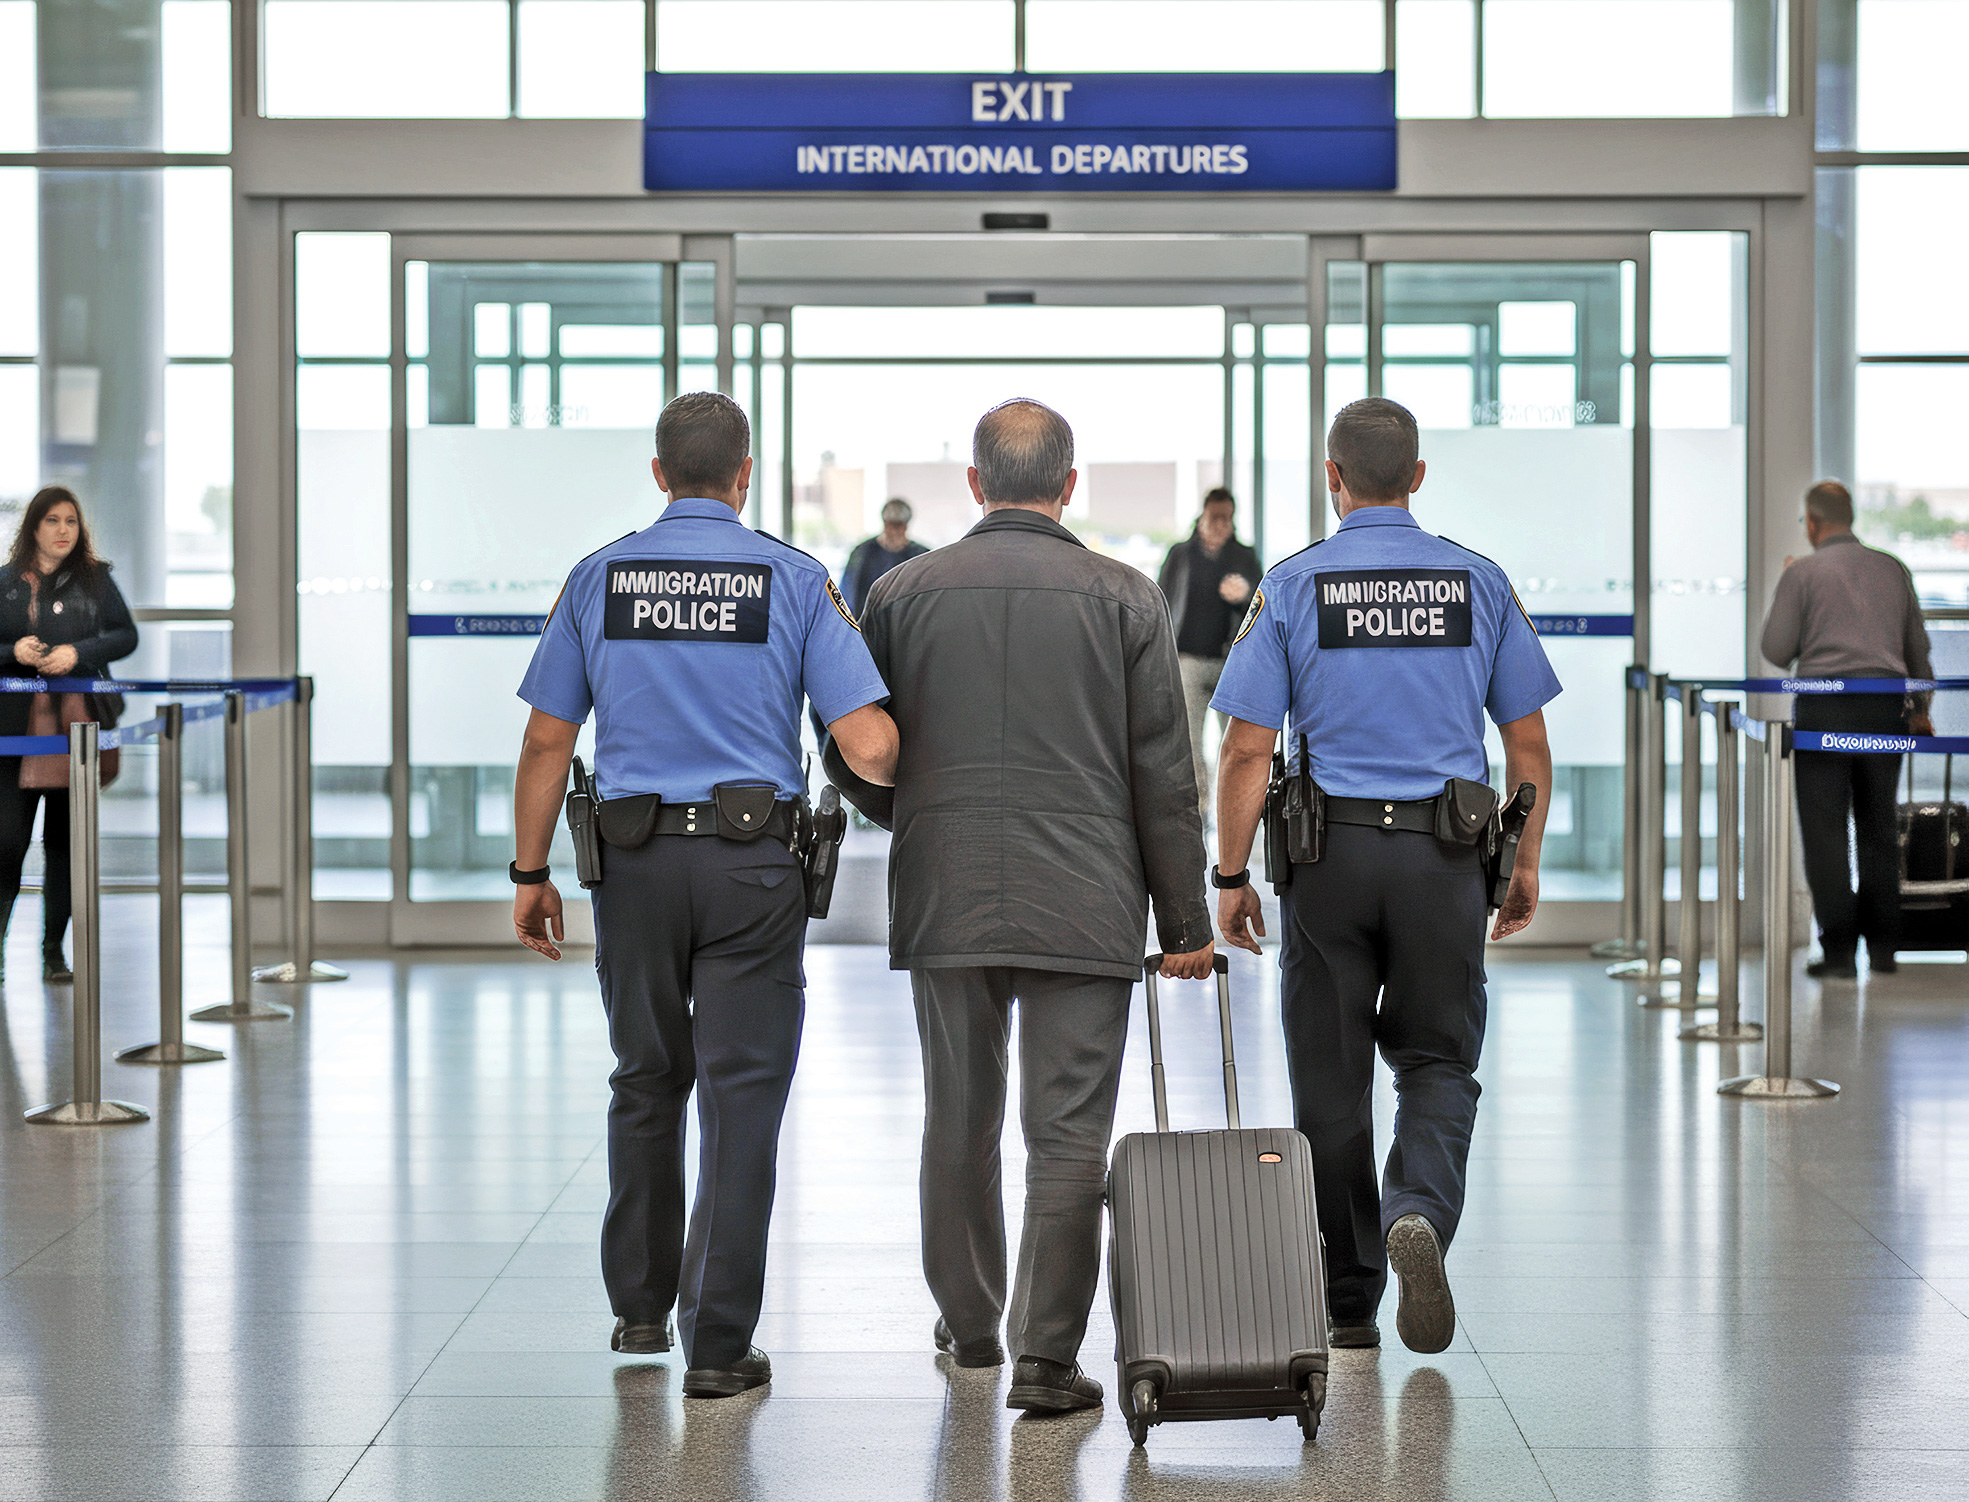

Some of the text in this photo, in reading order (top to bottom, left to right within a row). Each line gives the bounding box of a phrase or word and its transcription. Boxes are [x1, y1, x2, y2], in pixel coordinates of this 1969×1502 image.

[971, 81, 1073, 122] EXIT
[797, 144, 1249, 174] INTERNATIONAL DEPARTURES
[612, 571, 764, 598] IMMIGRATION
[633, 599, 737, 632] POLICE
[1346, 607, 1446, 637] POLICE
